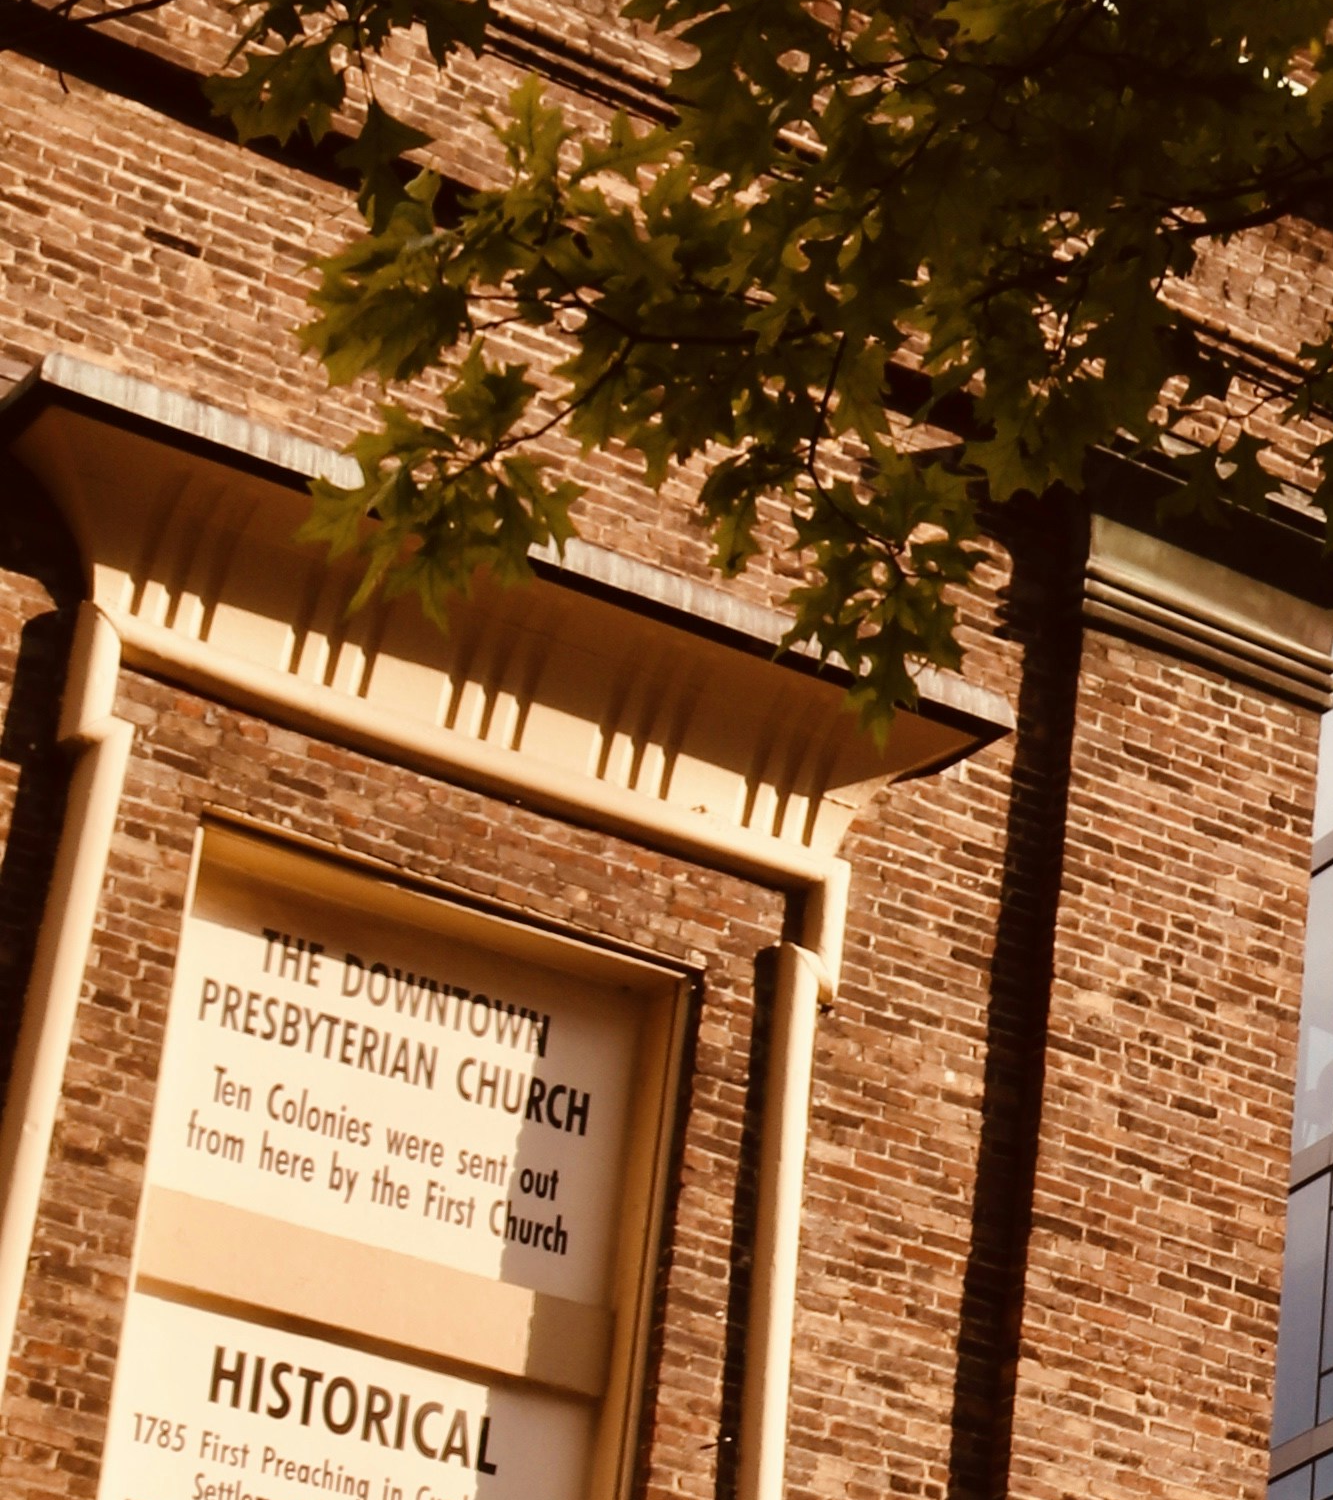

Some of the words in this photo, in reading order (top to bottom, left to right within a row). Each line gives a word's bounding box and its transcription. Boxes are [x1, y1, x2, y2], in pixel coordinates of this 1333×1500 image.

[197, 977, 438, 1090] PRESBYTERIAN
[456, 1056, 591, 1137] CHURCH
[261, 927, 325, 988] THE
[340, 952, 551, 1059] DOWNTOWN
[186, 1108, 245, 1164] from
[258, 1129, 315, 1183] here
[328, 1150, 359, 1202] by
[370, 1164, 411, 1211] the
[423, 1179, 476, 1229] First
[488, 1199, 569, 1256] Church
[213, 1065, 252, 1113] Ten
[266, 1083, 373, 1148] Colonies
[386, 1127, 445, 1169] were
[456, 1149, 509, 1187] sent
[519, 1167, 560, 1202] out
[133, 1412, 188, 1453] 1785
[199, 1429, 250, 1469] First
[208, 1345, 498, 1477] HISTORICAL
